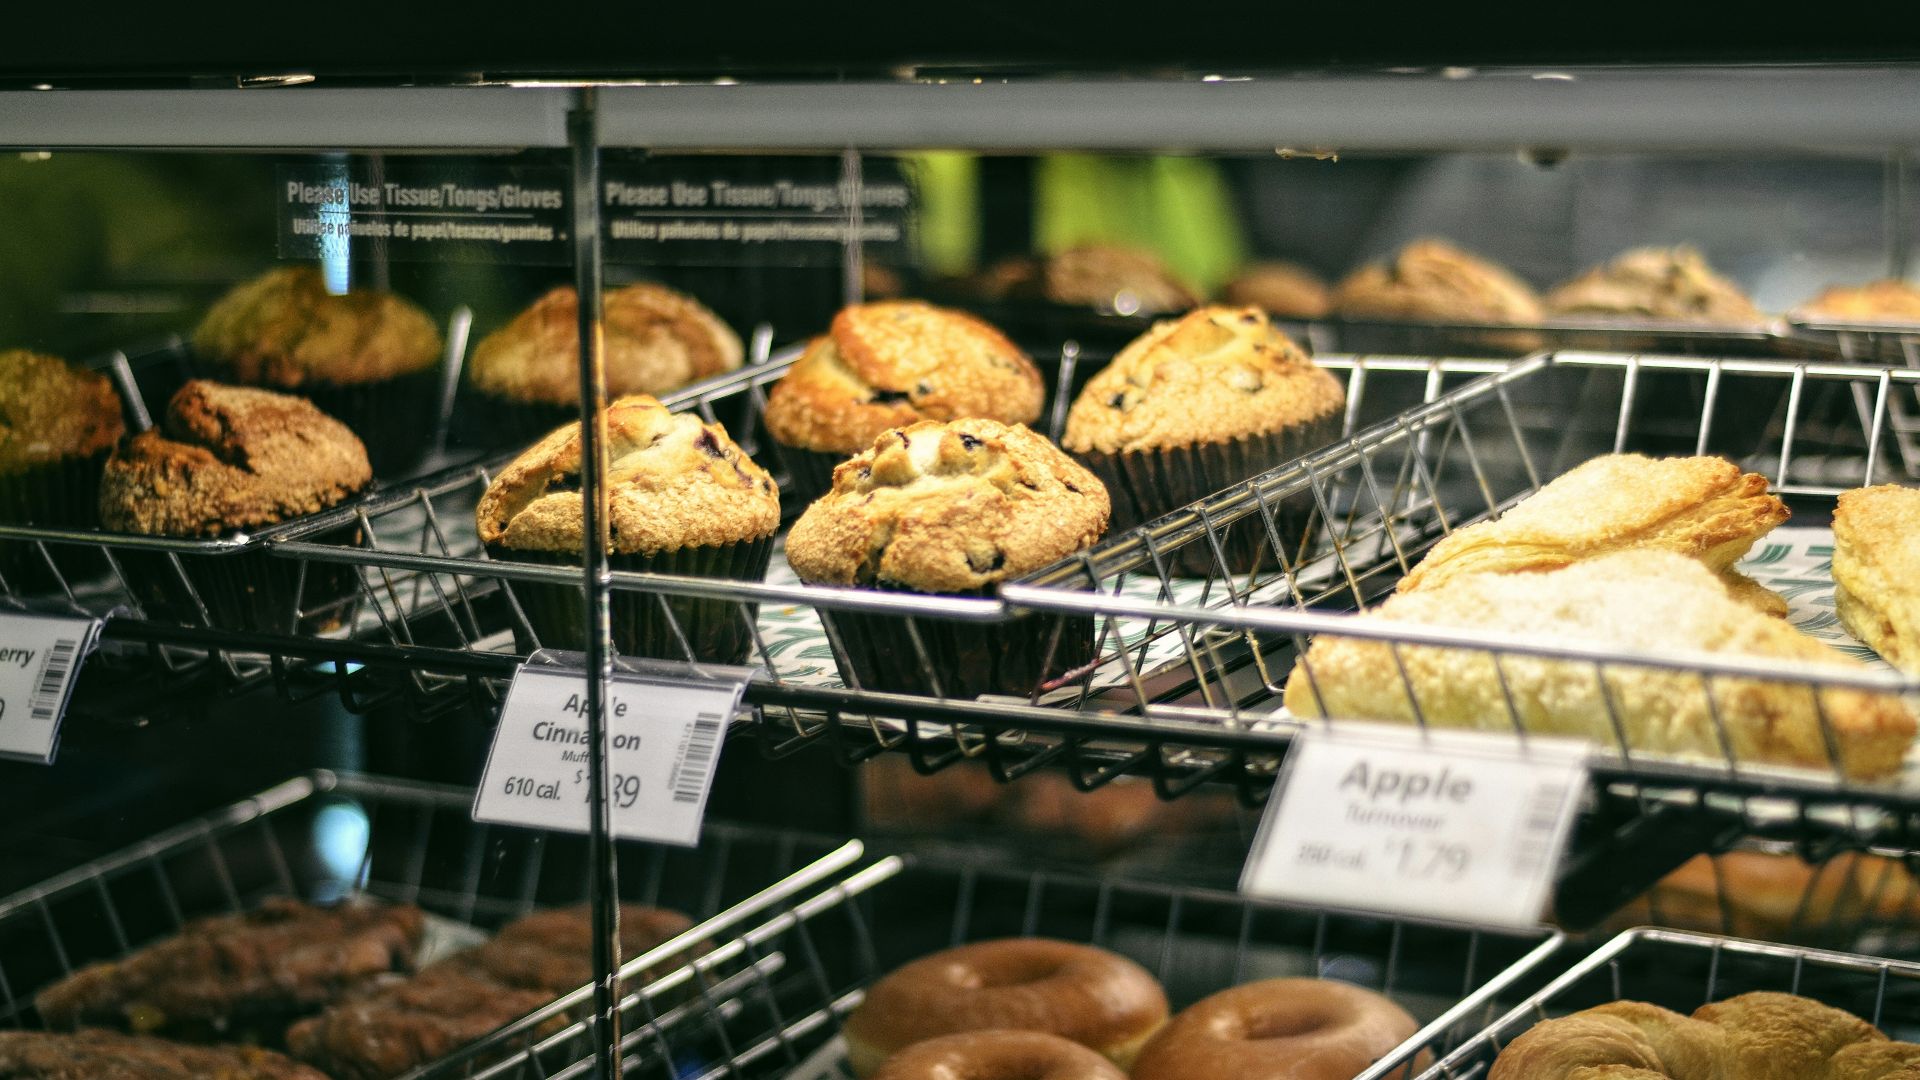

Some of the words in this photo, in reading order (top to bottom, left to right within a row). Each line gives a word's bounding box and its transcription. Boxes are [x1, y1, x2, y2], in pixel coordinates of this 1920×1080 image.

[287, 181, 345, 205] Please
[349, 182, 380, 205] Use
[384, 182, 563, 212] Tissue/Tongs/Gloves
[605, 181, 669, 206] Please
[671, 181, 708, 206] Use
[393, 220, 410, 238] de
[533, 721, 641, 750] Cinnaon
[504, 776, 534, 797] 610
[536, 780, 561, 800] cal.
[1338, 760, 1472, 802] Apple
